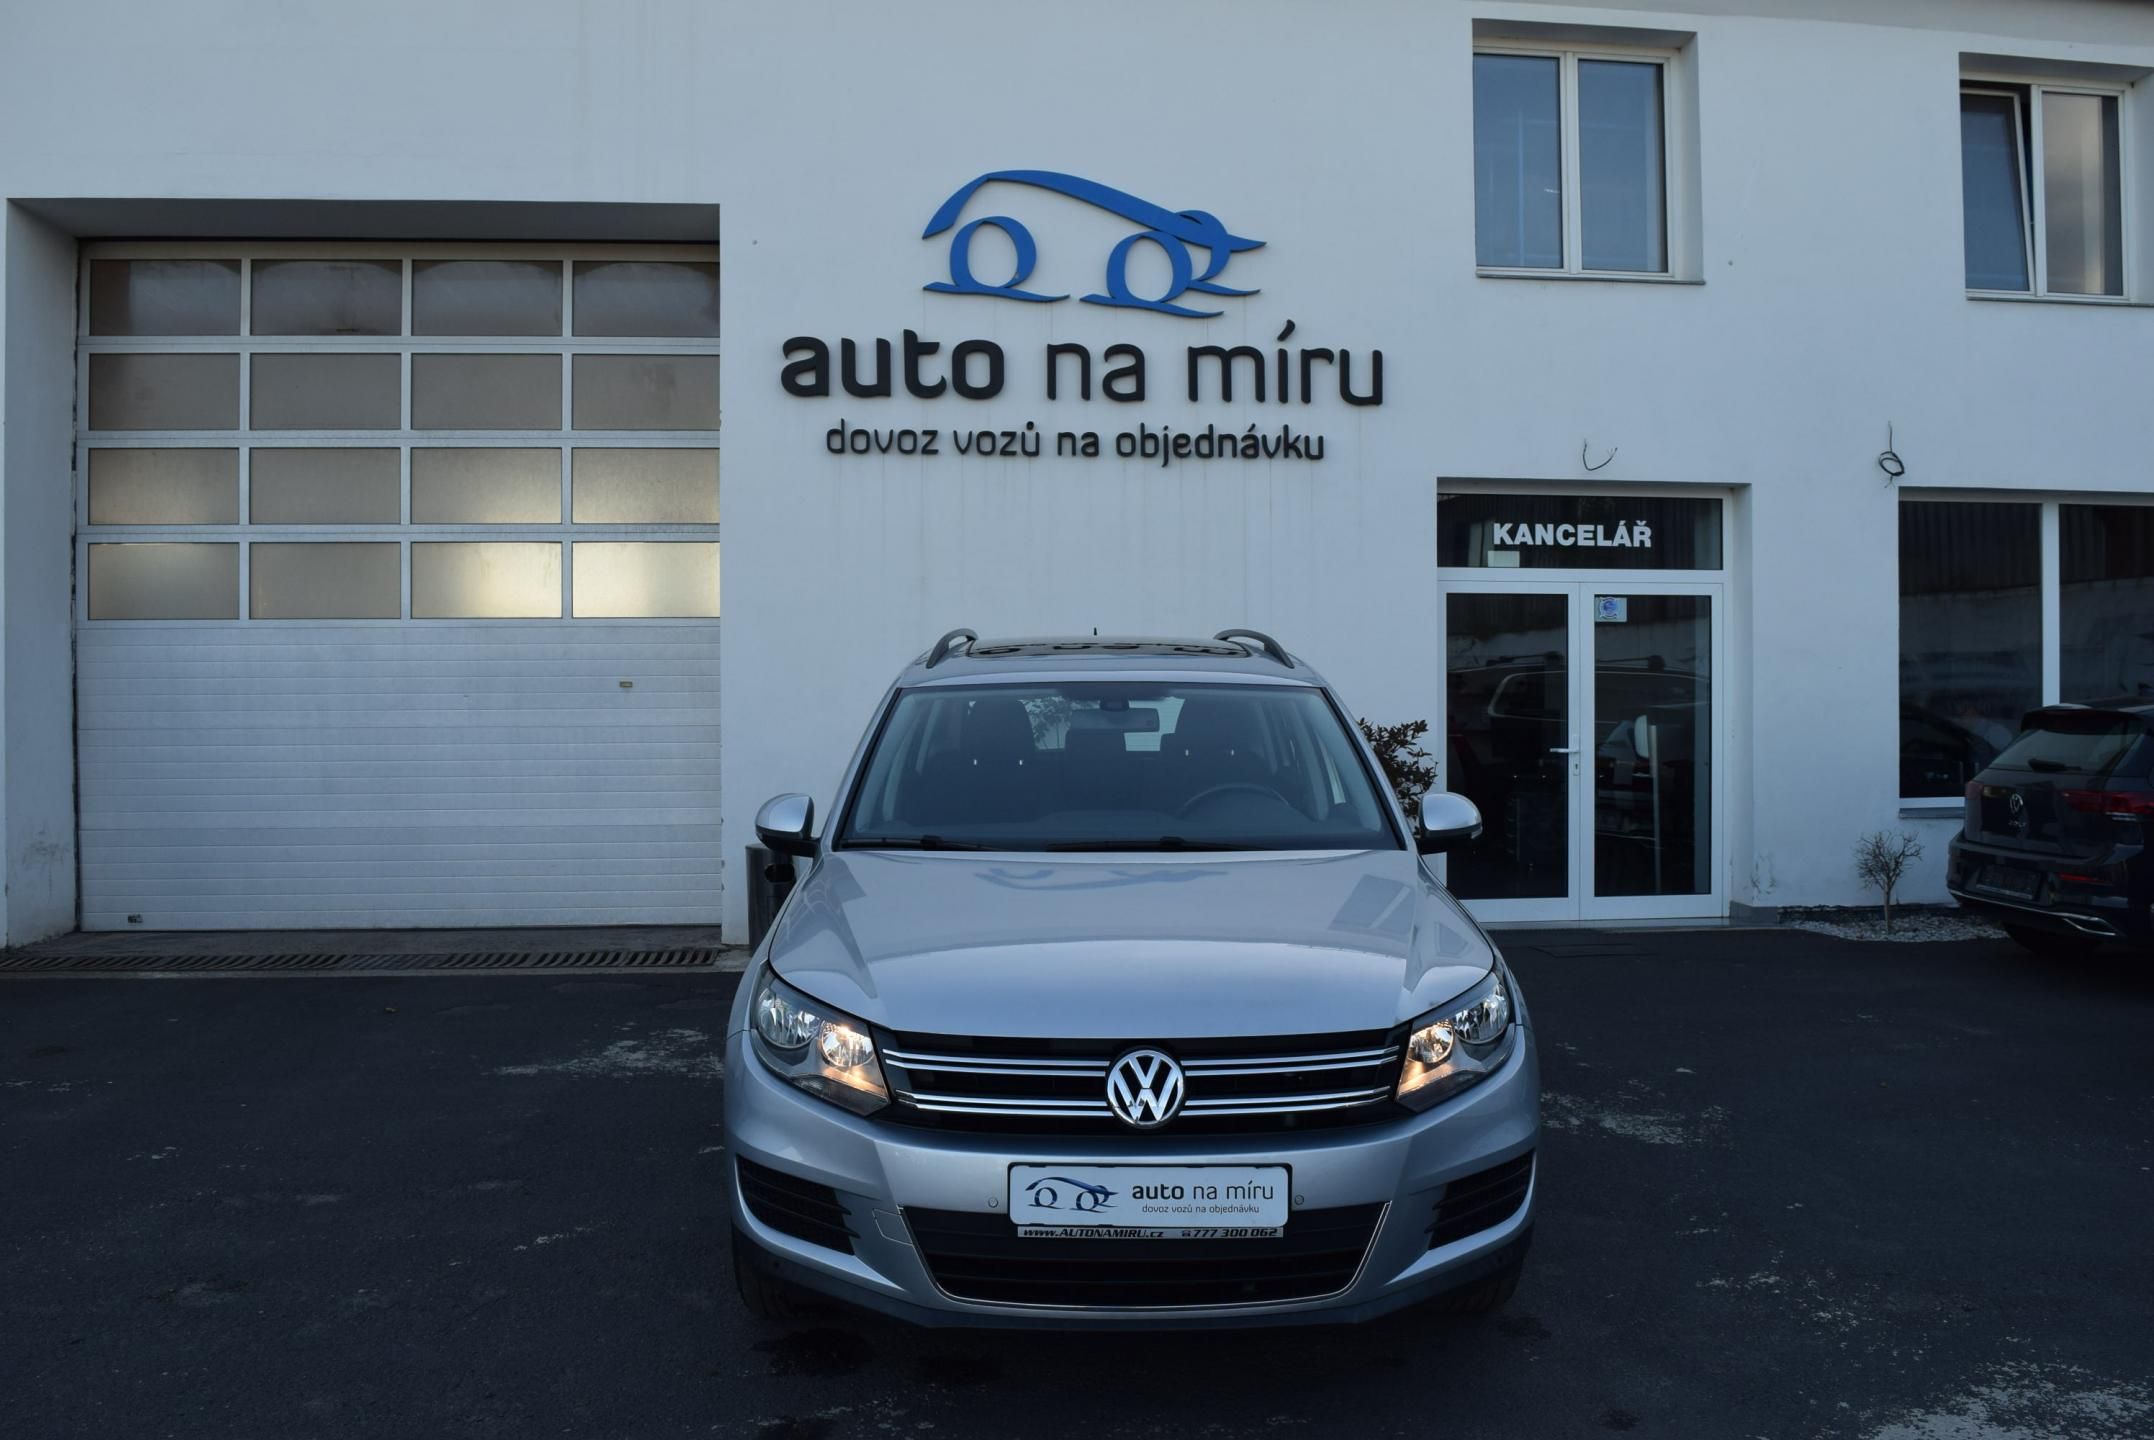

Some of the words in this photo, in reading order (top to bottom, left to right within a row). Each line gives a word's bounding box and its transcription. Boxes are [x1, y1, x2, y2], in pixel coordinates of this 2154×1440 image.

[780, 328, 1005, 399] auto
[1047, 342, 1146, 401] na
[1187, 319, 1383, 406] míru
[826, 418, 939, 455] dovoz
[953, 420, 1040, 457] vozů
[1057, 431, 1100, 457] na
[1115, 423, 1325, 467] objednávku
[1493, 521, 1652, 547] KANCELÁŘ
[1132, 1183, 1185, 1200] auto
[1192, 1185, 1218, 1200] na
[1226, 1180, 1274, 1200] míru
[1142, 1204, 1169, 1214] dovoz
[1171, 1204, 1193, 1214] vozů
[1195, 1206, 1207, 1214] na
[1209, 1204, 1260, 1215] objednávku
[1023, 1227, 1164, 1239] www.AUTONAMIRU.cz
[1192, 1228, 1220, 1238] 777
[1221, 1228, 1248, 1238] 300
[1250, 1228, 1277, 1237] 062
